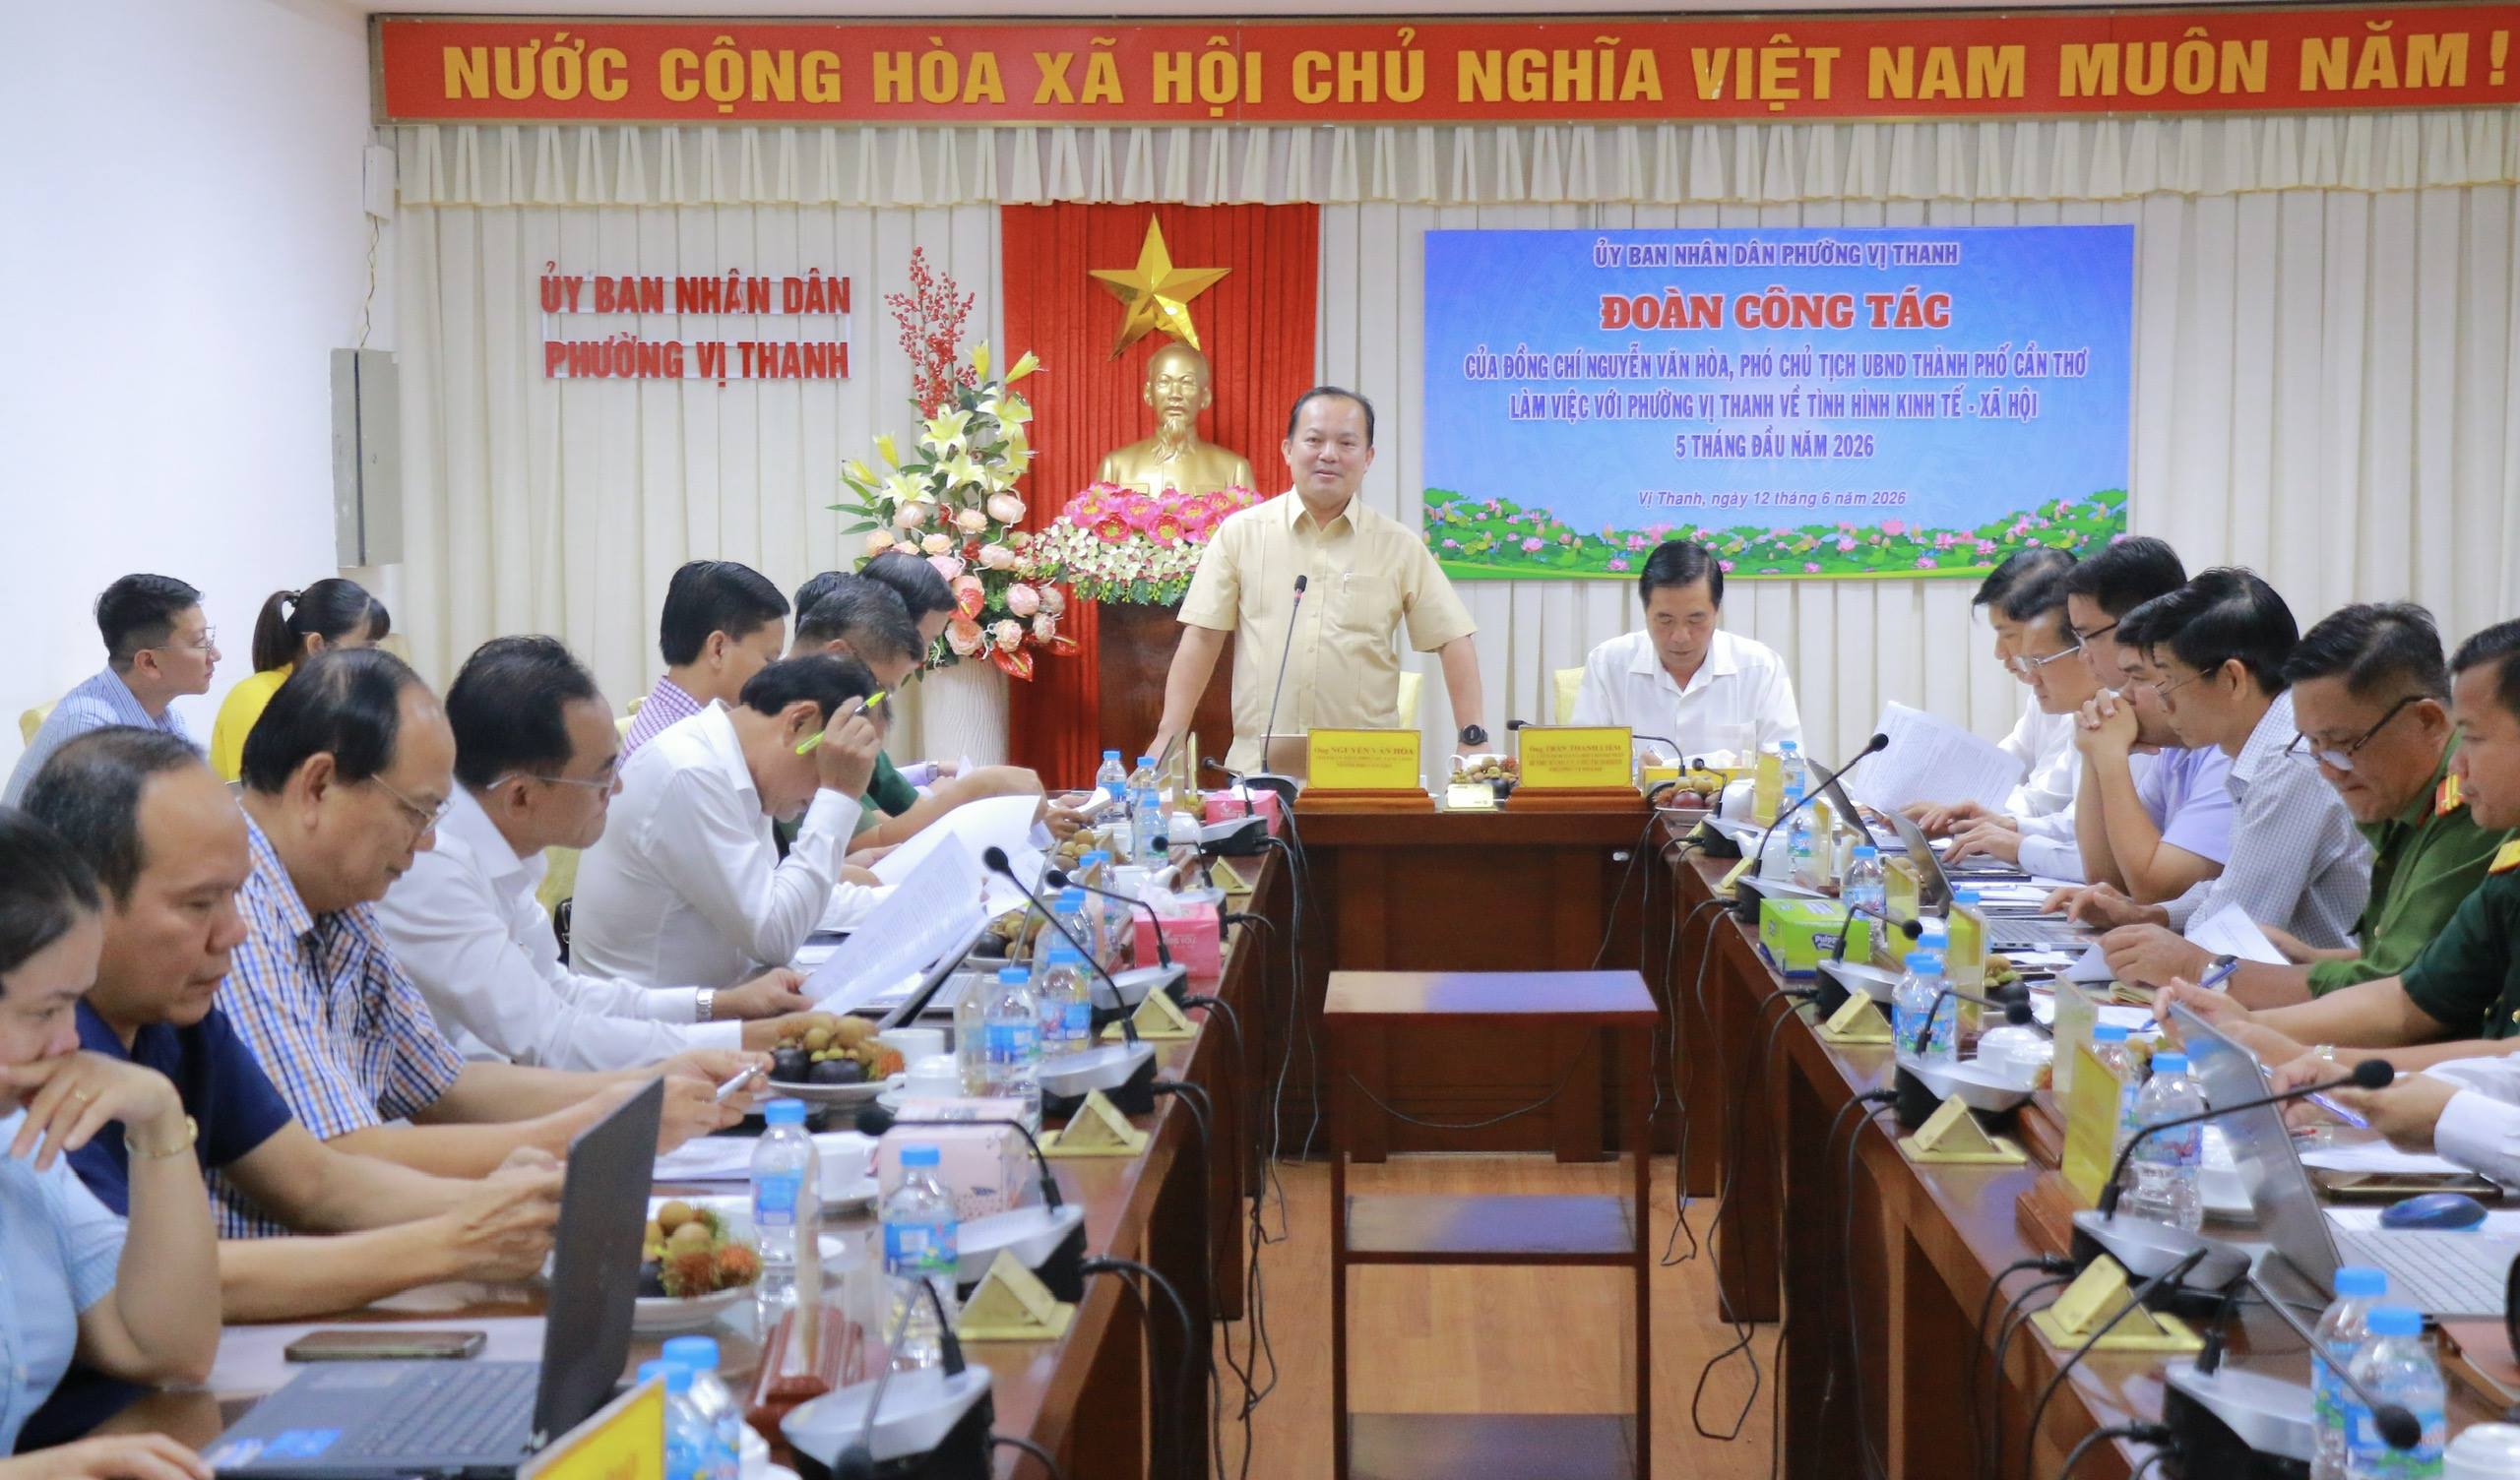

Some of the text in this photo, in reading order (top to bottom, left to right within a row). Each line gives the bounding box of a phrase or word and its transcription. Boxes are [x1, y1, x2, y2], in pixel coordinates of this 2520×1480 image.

[443, 31, 629, 100] NƯỚC
[659, 35, 843, 115] CỘNG
[872, 35, 1005, 105] HÒA
[1033, 37, 1124, 105] XÃ
[1152, 35, 1263, 118] HỘI
[1291, 27, 1426, 105] CHỦ
[1457, 35, 1664, 104] NGHĨA
[1690, 32, 1842, 113] VIỆT
[1866, 45, 2027, 100] NAM
[2058, 28, 2269, 97] MUÔN
[2300, 22, 2469, 92] NĂM
[1594, 239, 1959, 270] ỦY BAN NHÂN DÂN PHƯỜNG VỊ THANH
[539, 260, 851, 315] ỦY BAN NHÂN DÂN
[1601, 285, 1950, 330] ĐOÀN CÔNG TÁC
[544, 332, 849, 388] PHƯỜNG VỊ THANH
[1465, 341, 2089, 383] CỦA ĐỒNG CHÍ NGUYỄN VĂN HÒA, PHÓ CHỦ TỊCH UBND THÀNH PHỐ CẦN THƠ
[1509, 389, 1546, 420] LÀM
[1550, 388, 1589, 424] VIỆC
[1594, 389, 1622, 419] VỚI
[1627, 388, 1694, 419] PHƯỜNG
[1698, 394, 1714, 424] VỊ
[1721, 394, 1774, 419] THANH
[1780, 385, 1800, 418] VỀ
[1806, 388, 1846, 418] TÌNH
[1851, 388, 1890, 418] HÌNH
[1895, 392, 1935, 418] KINH
[1939, 385, 1966, 418] TẾ
[1980, 388, 2001, 418] XÃ
[2007, 387, 2038, 422] HỘI
[1674, 425, 1875, 460] 5 THÁNG ĐẦU NĂM 2026
[1638, 490, 1907, 509] Vị Thanh, ngày 12 tháng 6 năm 2026
